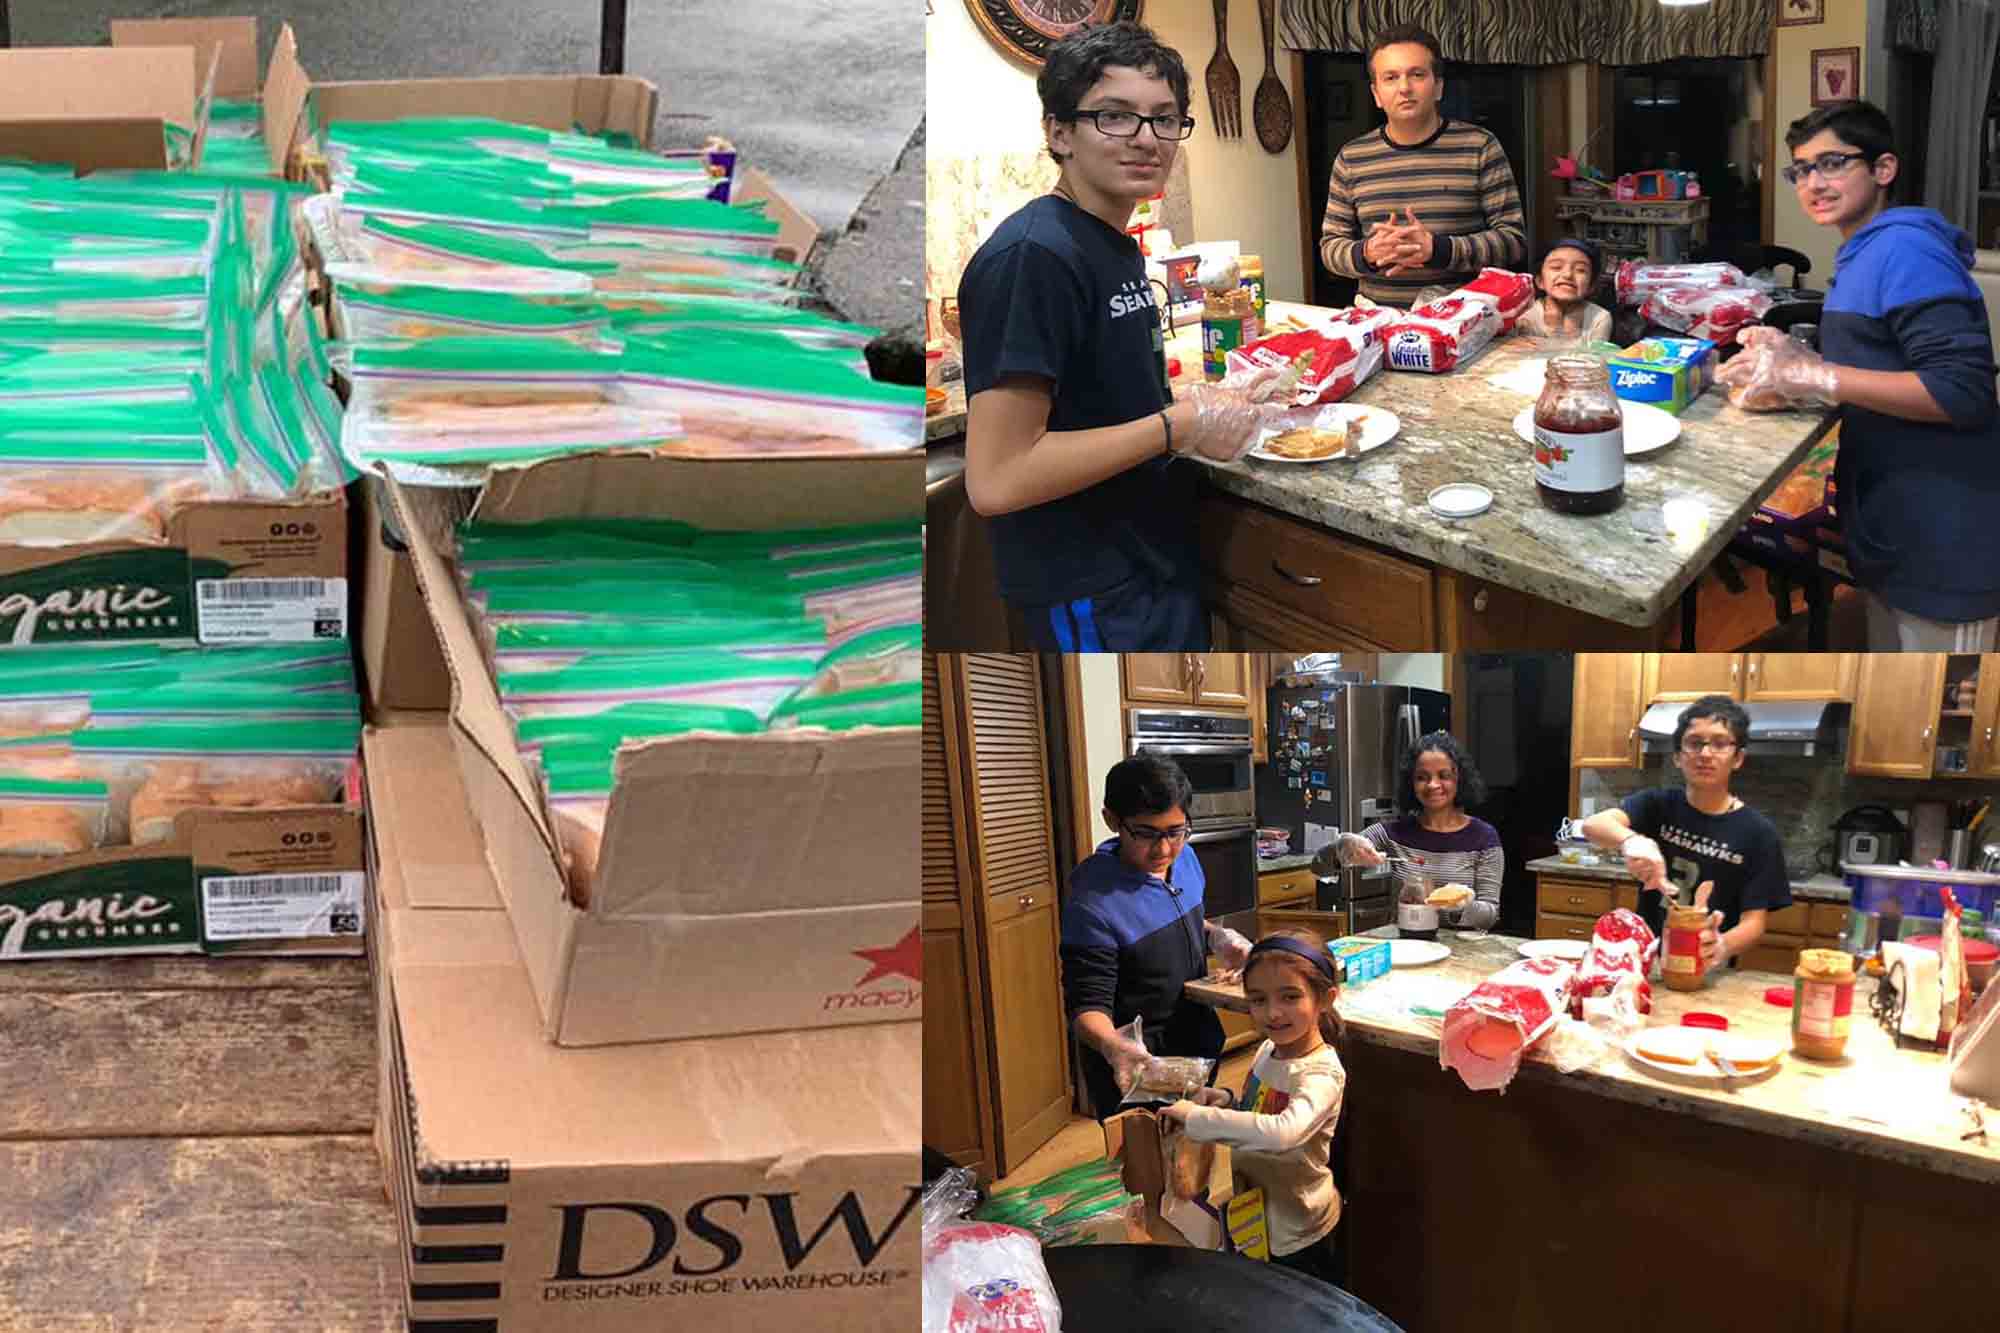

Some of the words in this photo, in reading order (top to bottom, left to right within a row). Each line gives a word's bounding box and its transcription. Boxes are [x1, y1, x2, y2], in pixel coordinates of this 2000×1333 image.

[1391, 351, 1430, 368] WHITE
[1616, 370, 1657, 388] Ziploc
[545, 1184, 921, 1281] DSW
[543, 1281, 665, 1302] DESIGNER
[669, 1278, 730, 1295] SHOE
[741, 1271, 893, 1293] WAREHOUSE
